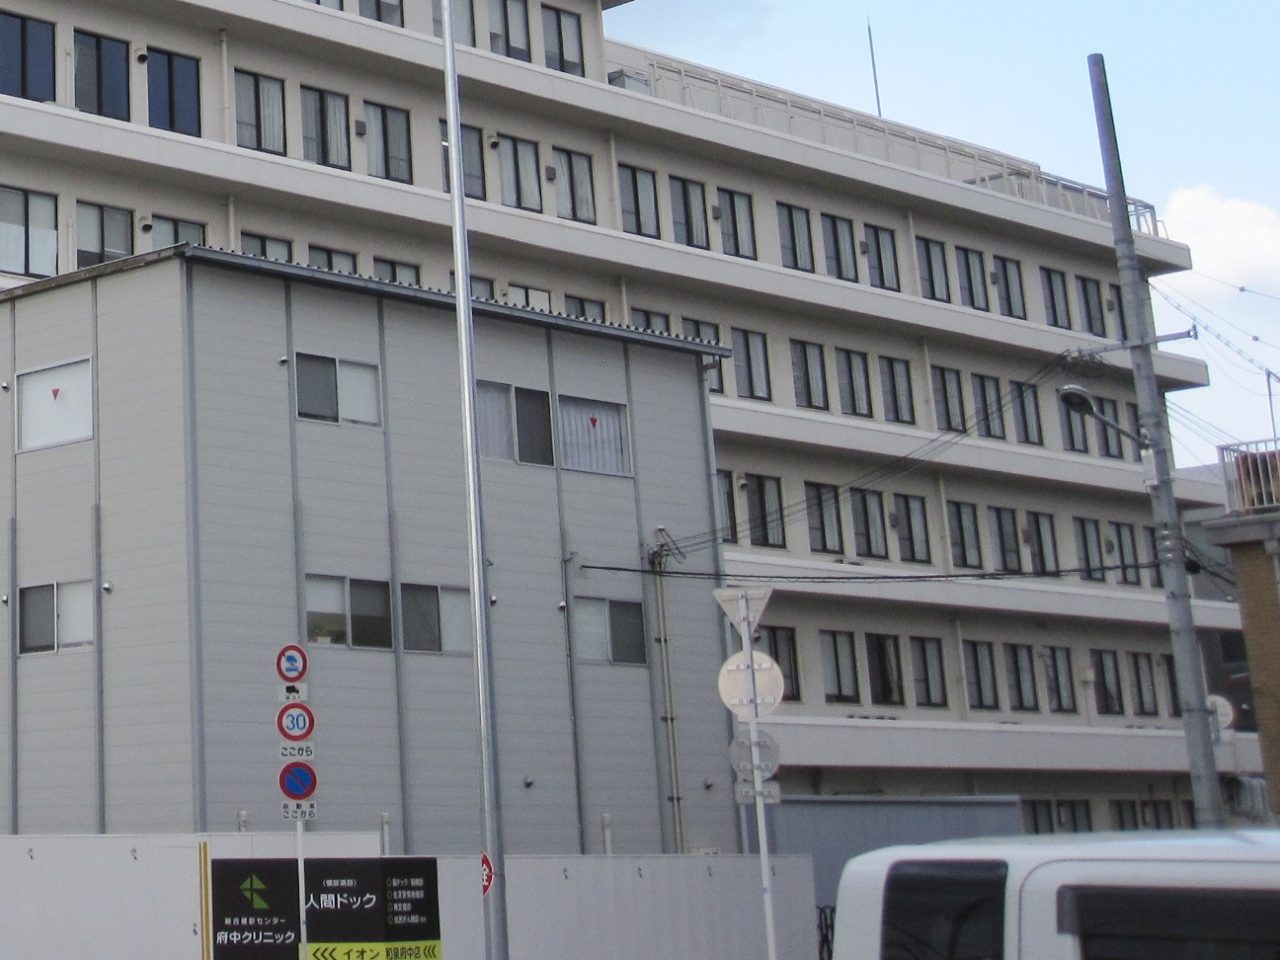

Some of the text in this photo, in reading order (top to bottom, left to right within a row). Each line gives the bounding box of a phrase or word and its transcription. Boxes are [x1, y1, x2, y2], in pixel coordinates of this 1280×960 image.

[286, 714, 306, 730] 30
[281, 746, 313, 757] ここから
[283, 810, 316, 819] ここから
[305, 893, 376, 909] 人間ドック
[216, 931, 295, 945] 府中クリニック
[343, 947, 380, 960] イオン
